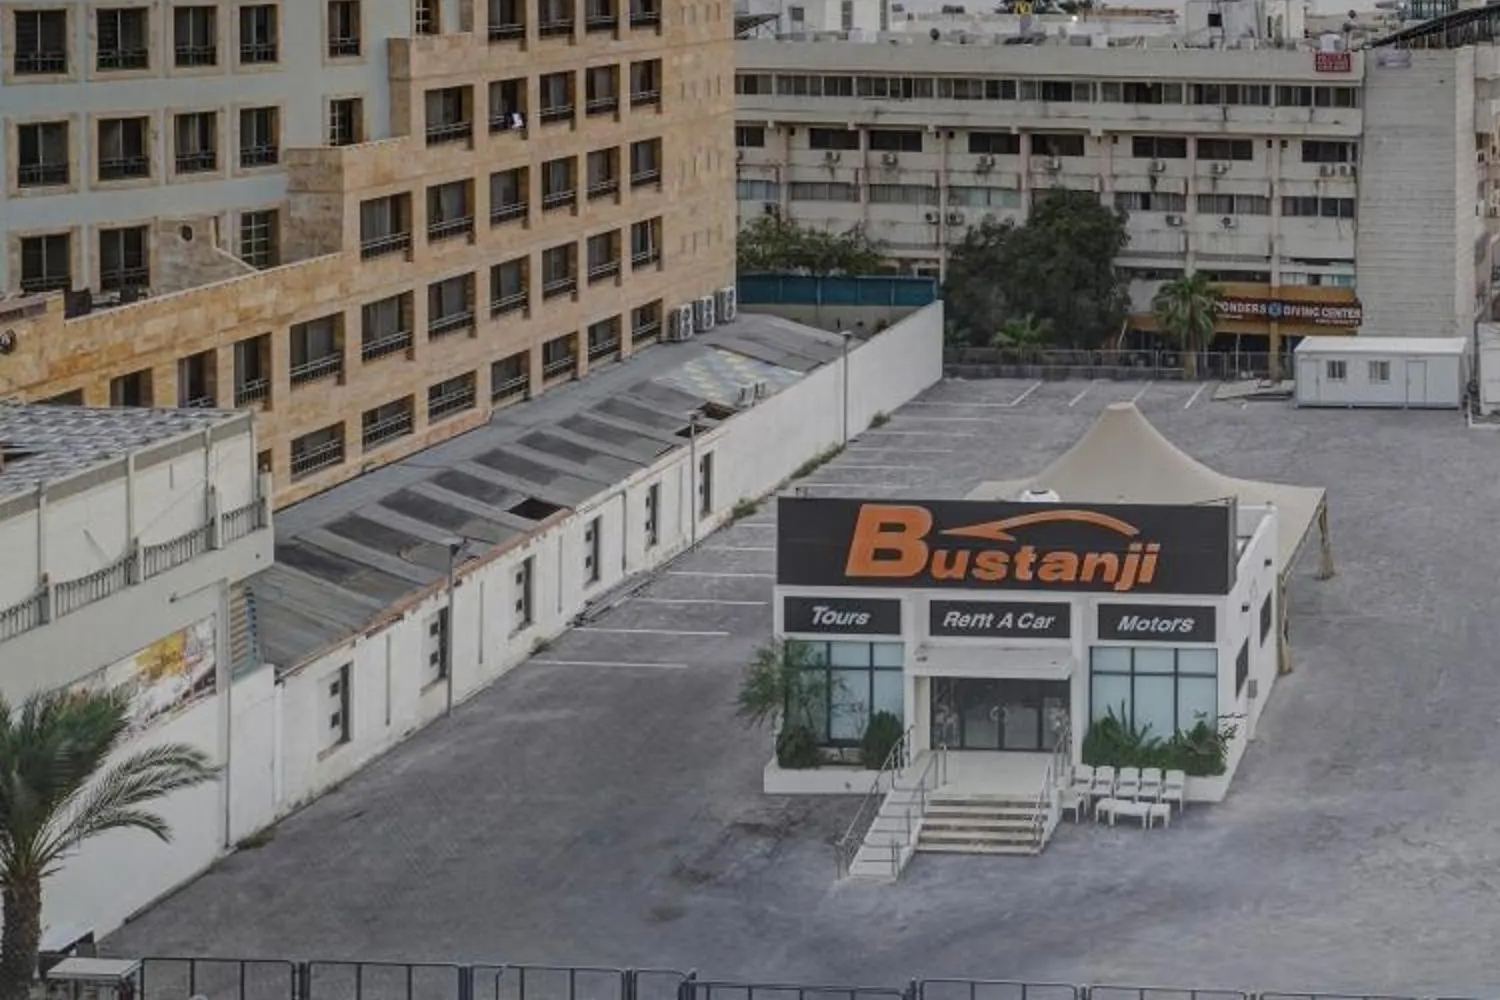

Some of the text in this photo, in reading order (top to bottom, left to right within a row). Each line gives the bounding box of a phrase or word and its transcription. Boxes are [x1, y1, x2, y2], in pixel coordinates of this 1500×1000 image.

[1216, 301, 1267, 315] ONDERS
[845, 503, 1161, 591] Bustanji
[812, 605, 872, 625] Tours
[943, 611, 1056, 629] Rent A Car
[1117, 615, 1195, 633] Motors
